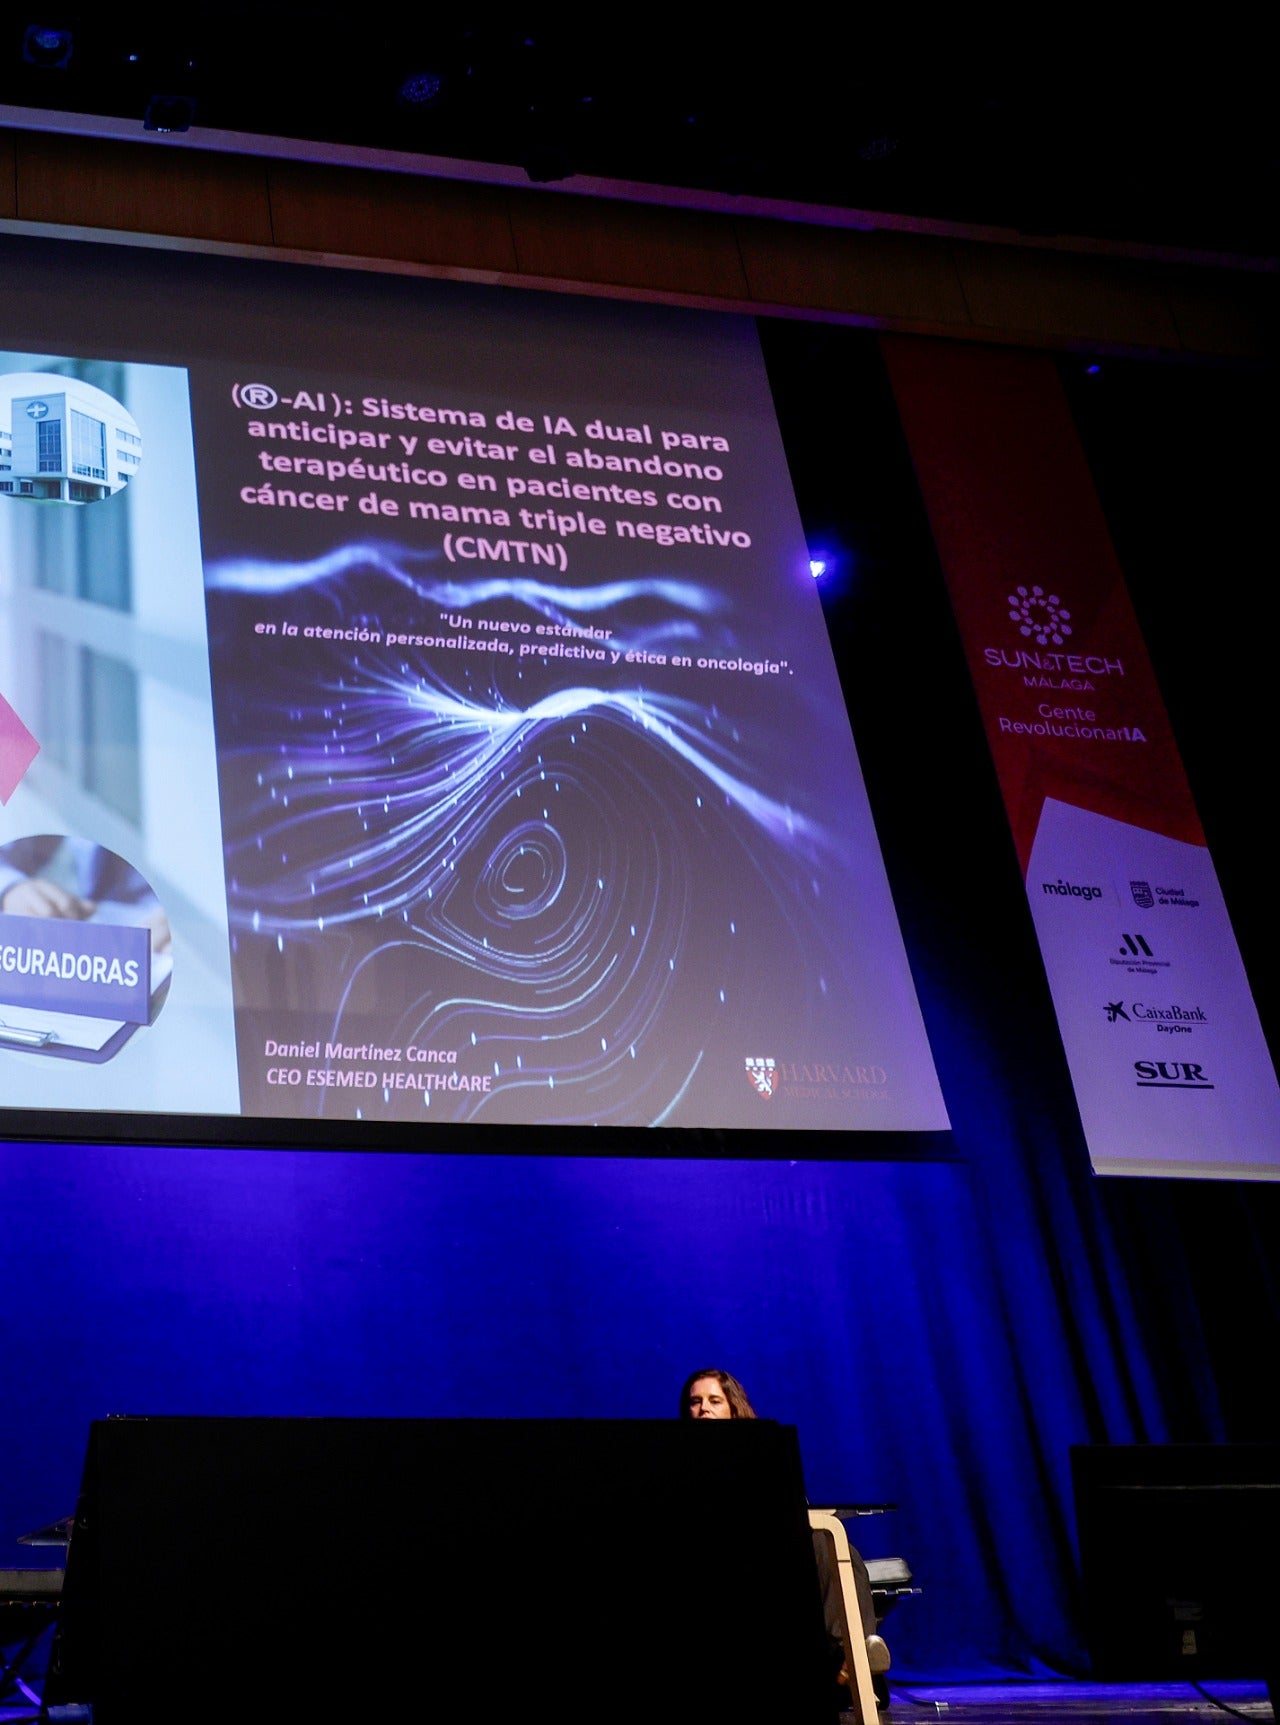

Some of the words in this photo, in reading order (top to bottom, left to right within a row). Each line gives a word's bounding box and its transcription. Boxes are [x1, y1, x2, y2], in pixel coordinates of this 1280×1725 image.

[362, 397, 486, 428] Sistema
[496, 411, 534, 432] de
[543, 415, 577, 437] IA
[585, 420, 652, 444] dual
[661, 431, 730, 452] para
[248, 420, 391, 449] anticipar
[399, 435, 418, 456] y
[427, 436, 519, 461] evitar
[528, 444, 556, 465] el
[566, 448, 723, 481] abandono
[258, 451, 447, 486] terapéutico
[457, 472, 497, 491] en
[506, 476, 658, 507] pacientes
[666, 492, 723, 513] con
[240, 483, 349, 512] cáncer
[358, 493, 399, 516] de
[409, 501, 510, 527] mama
[519, 508, 606, 536] triple
[616, 520, 752, 548] negativo
[442, 533, 569, 571] (CMTN)
[440, 613, 473, 630] "Un
[478, 617, 531, 634] nuevo
[535, 620, 612, 640] estándar
[254, 622, 277, 635] en
[282, 622, 298, 637] la
[303, 627, 381, 643] atención
[386, 630, 515, 655] personalizada,
[520, 641, 606, 661] predictiva
[610, 651, 621, 664] y
[625, 649, 667, 665] ética
[671, 655, 692, 667] en
[1038, 703, 1096, 722] Gente
[999, 717, 1147, 742] RevolucionarIA
[1132, 1002, 1208, 1021] CaixaBank
[1156, 1024, 1192, 1035] DayOne
[265, 1040, 320, 1058] Daniel
[324, 1043, 402, 1062] Martínez
[406, 1046, 458, 1064] Canca
[267, 1067, 301, 1086] CEO
[306, 1068, 377, 1088] ESEMED
[382, 1072, 492, 1092] HEALTHCARE
[781, 1063, 887, 1084] HARVARD
[1134, 1060, 1208, 1081] SUR
